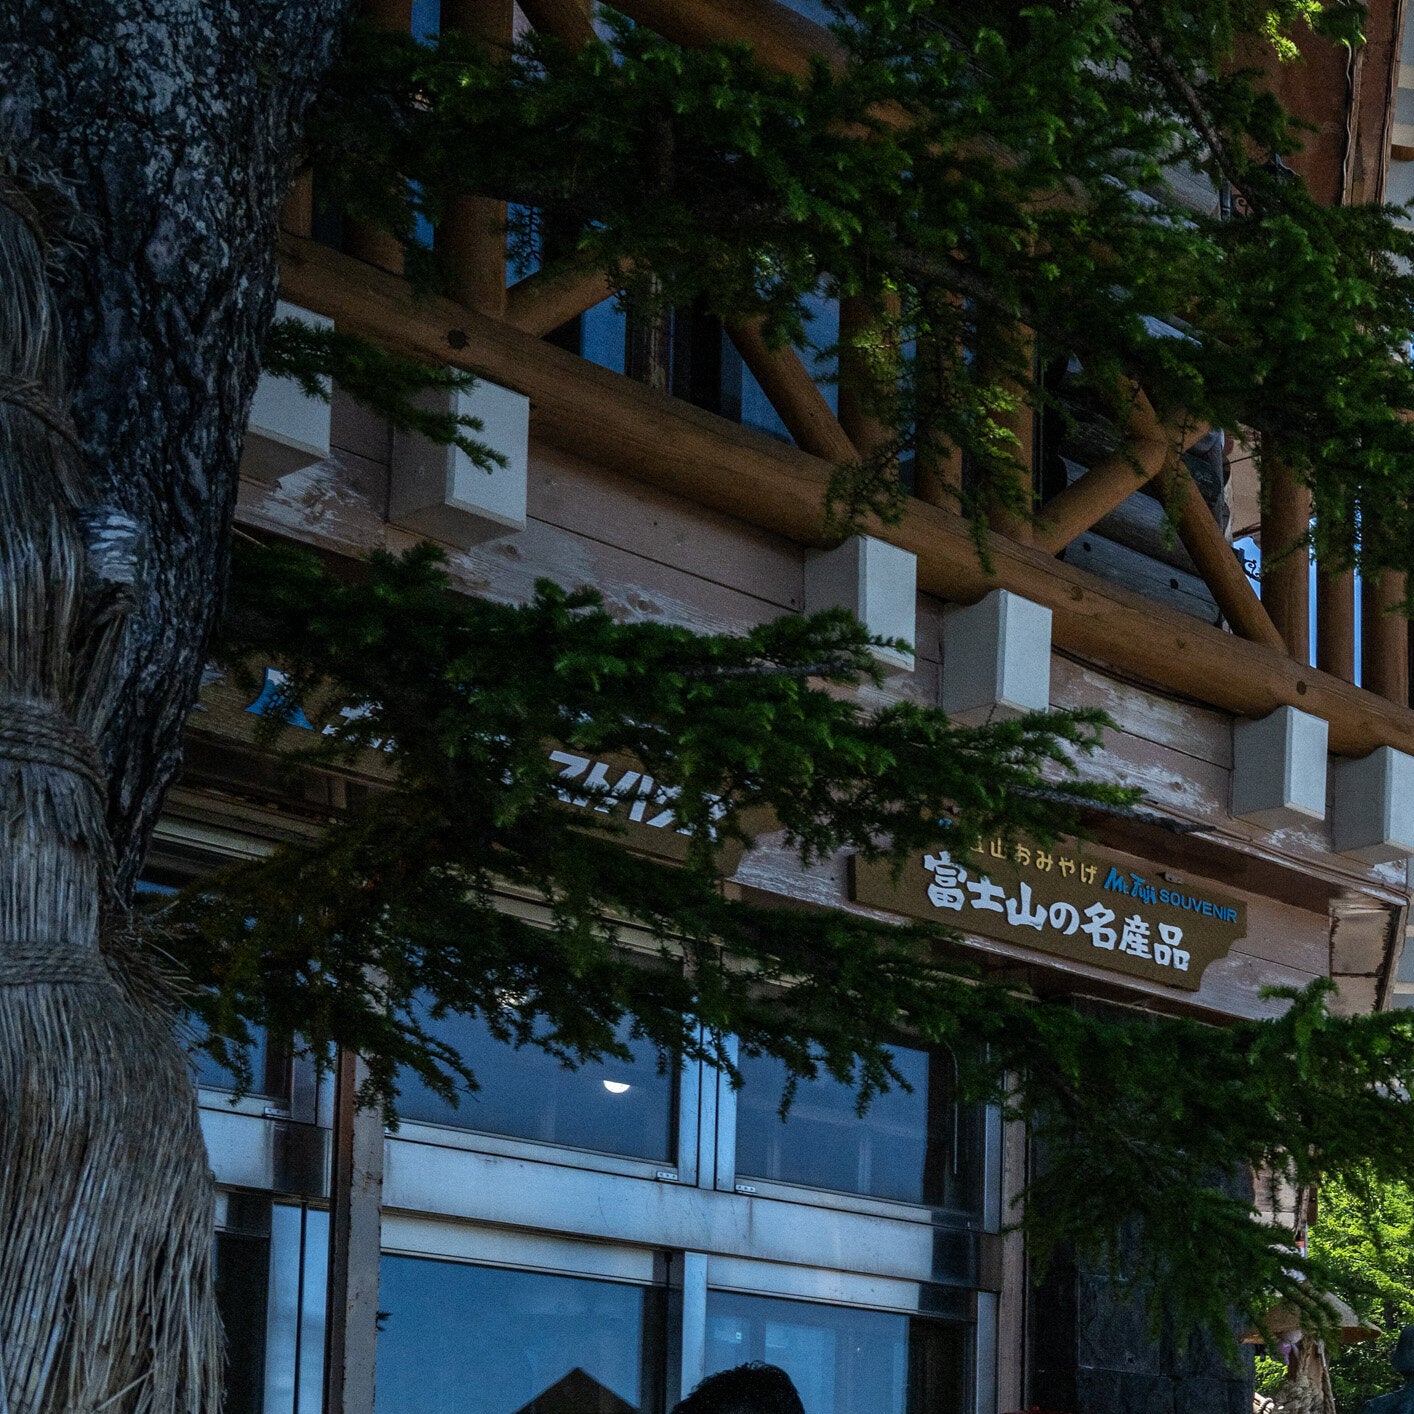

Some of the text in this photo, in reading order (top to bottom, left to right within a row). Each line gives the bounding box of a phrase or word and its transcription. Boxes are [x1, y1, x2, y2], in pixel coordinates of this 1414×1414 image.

[923, 850, 1191, 971] 富士山の名産品
[1130, 872, 1157, 904] Fuji
[1159, 889, 1237, 924] SOUVENIR
